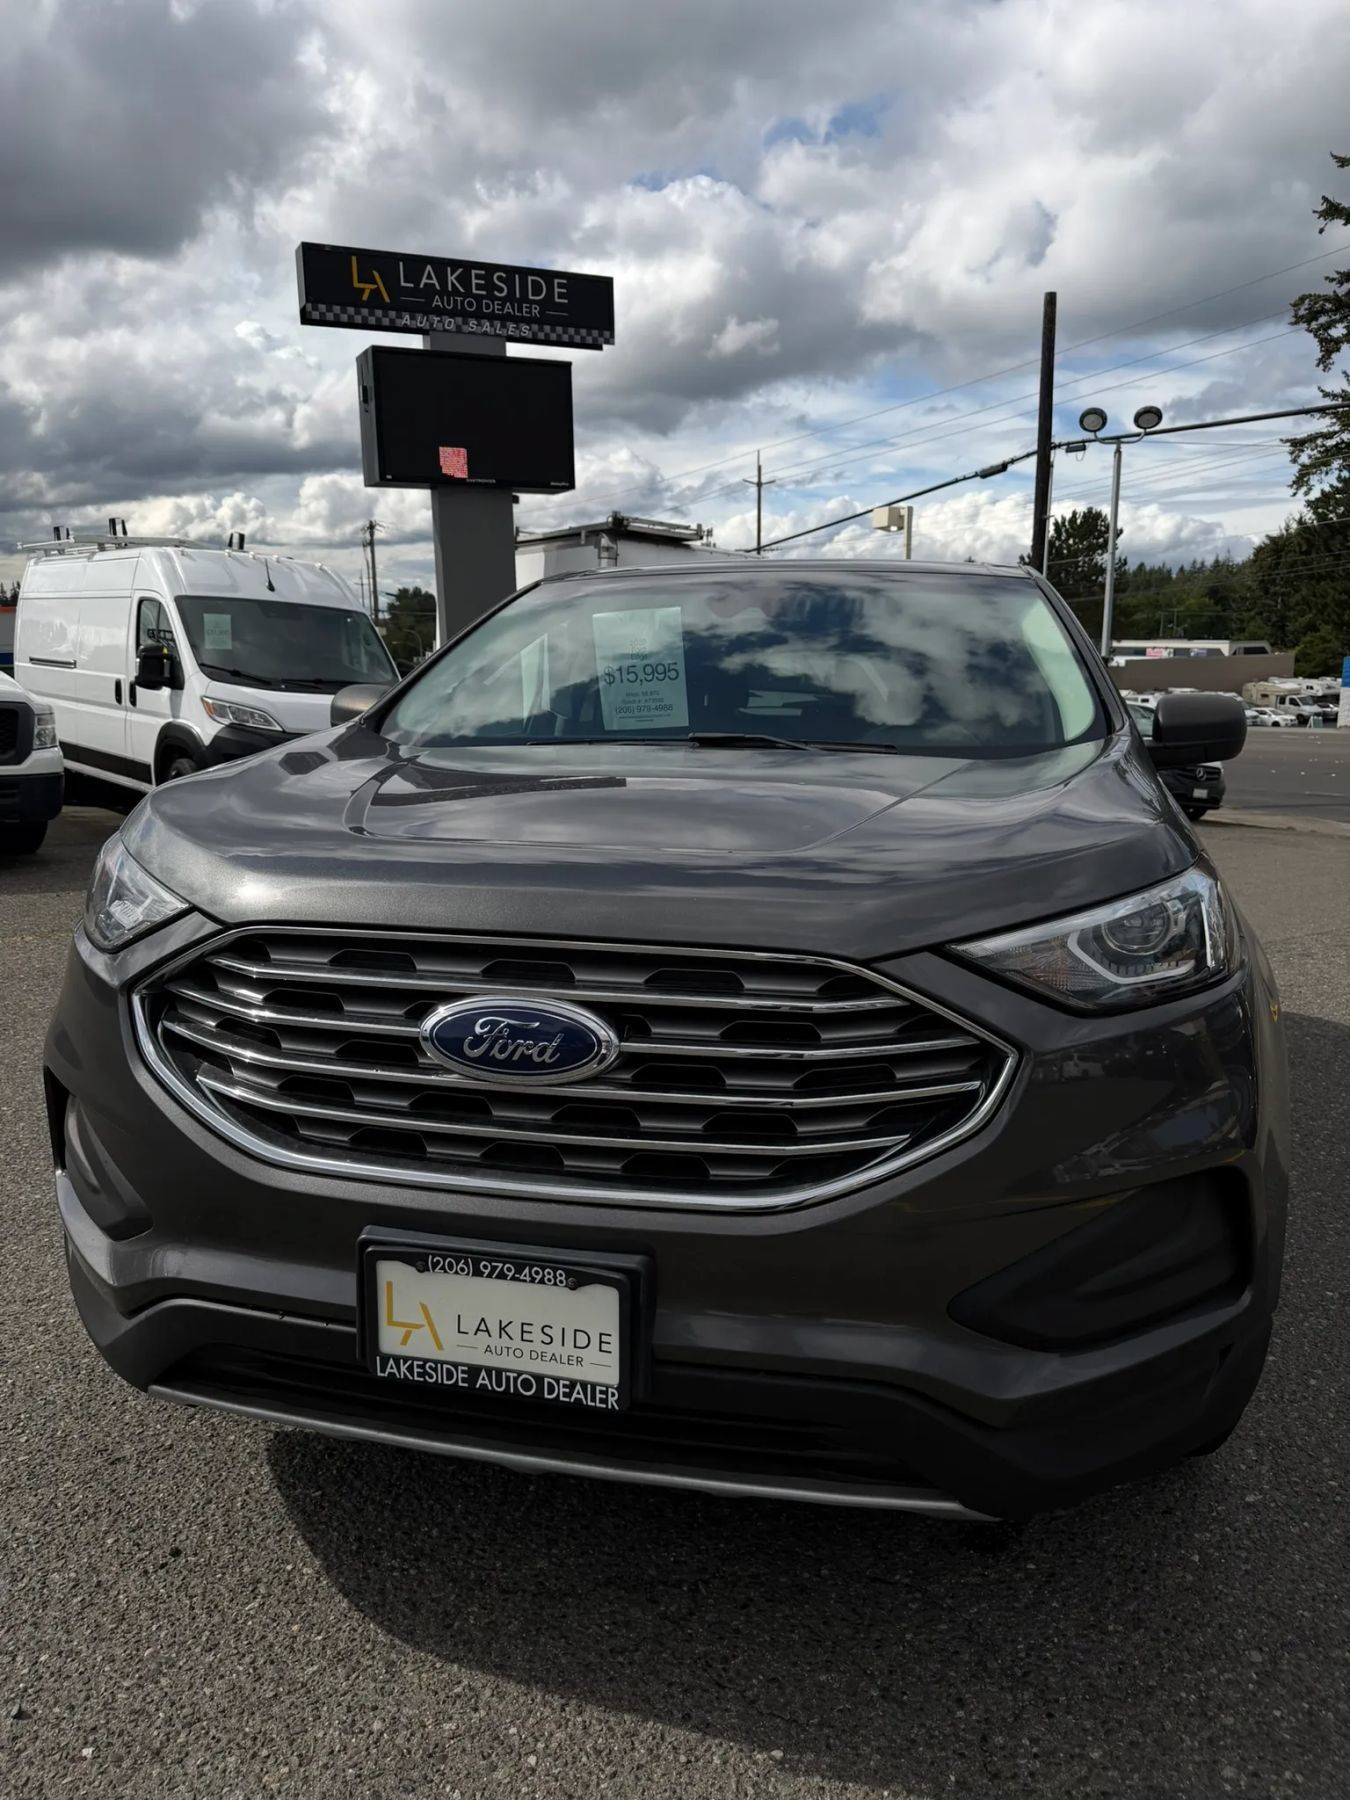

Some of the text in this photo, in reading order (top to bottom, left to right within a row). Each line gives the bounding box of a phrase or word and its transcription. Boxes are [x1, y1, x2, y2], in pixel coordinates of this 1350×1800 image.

[399, 261, 569, 304] LAKESIDE
[432, 295, 541, 318] AUTO DEALER
[401, 314, 531, 337] AUTO SALES
[603, 662, 680, 687] $15,995
[615, 705, 635, 715] (206)
[463, 1016, 565, 1064] Ford
[428, 1254, 567, 1287] (206) 979-4988
[456, 1313, 613, 1354] LAKESIDE
[484, 1344, 584, 1368] AUTO DEALER
[376, 1356, 619, 1410] LAKESIDE AUTO DEALER
